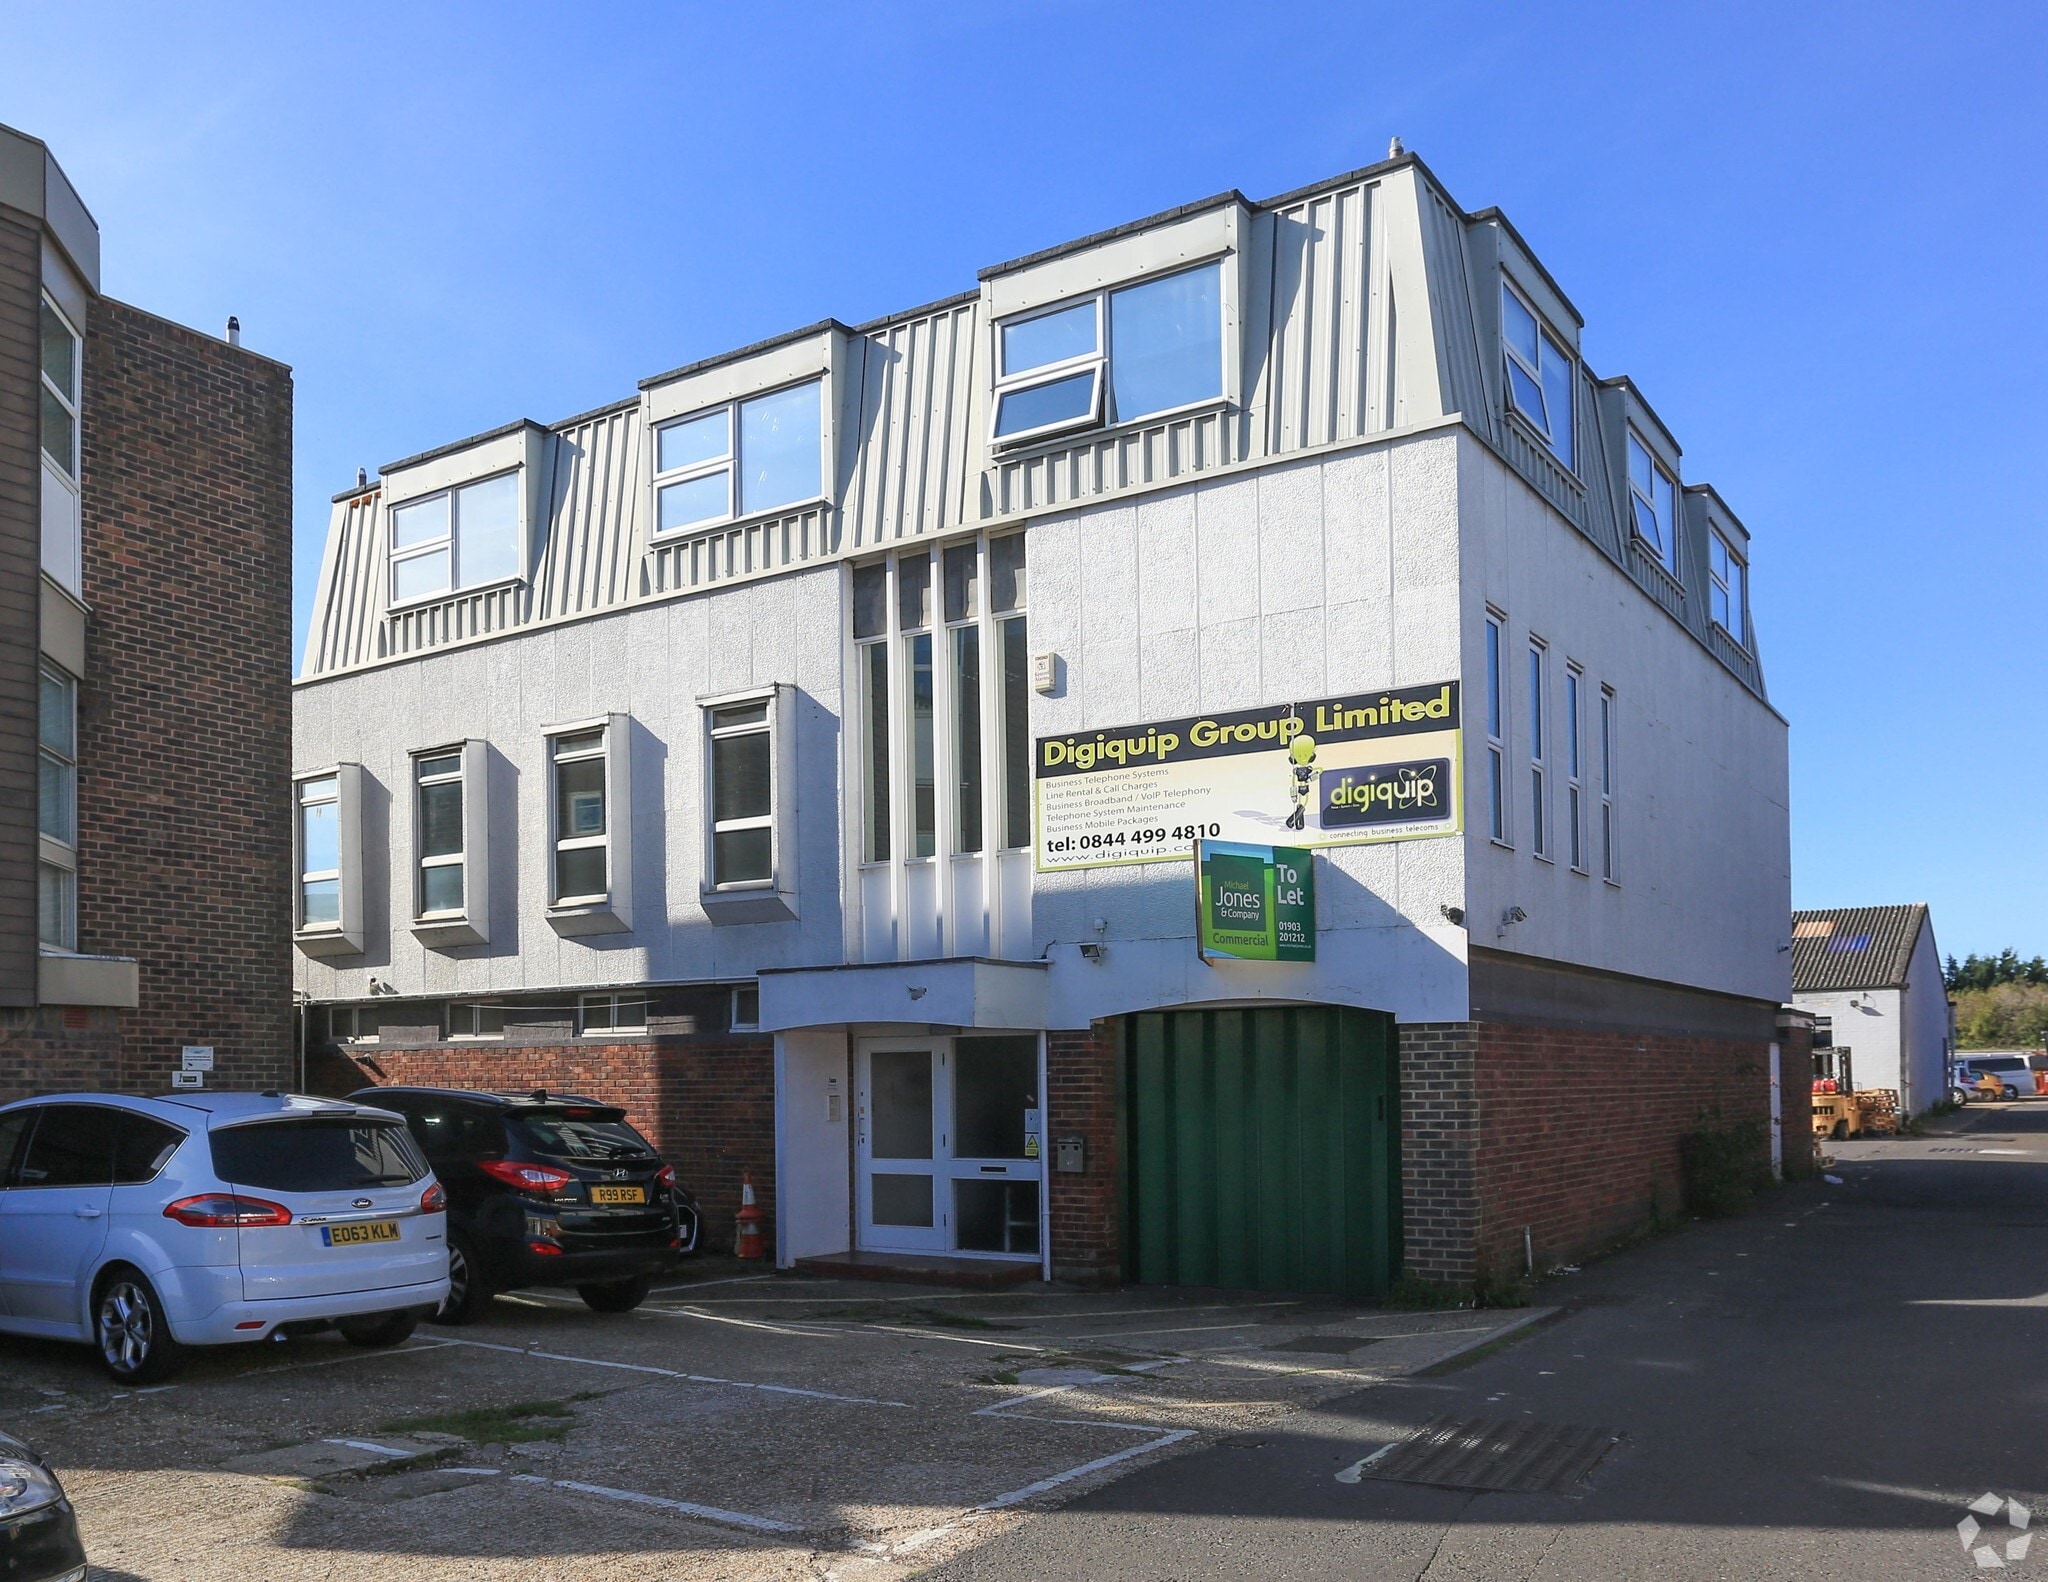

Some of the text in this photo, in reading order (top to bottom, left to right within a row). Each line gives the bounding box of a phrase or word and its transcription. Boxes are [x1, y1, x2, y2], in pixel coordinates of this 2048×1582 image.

[1044, 685, 1450, 770] Digiquip Group Limited
[1046, 769, 1169, 789] Business Telephone Systems
[1046, 781, 1158, 800] Line Rental & Call Charges
[1046, 801, 1082, 811] Business
[1085, 794, 1132, 807] Broadband
[1141, 791, 1161, 800] VoIP
[1163, 787, 1211, 798] Telephony
[1330, 771, 1434, 813] digiquip
[1046, 801, 1186, 822] Telephone System Maintenance
[1046, 815, 1159, 833] Business Mobile Packages
[1329, 824, 1439, 839] connecting business telecoms
[1047, 823, 1220, 852] tel: 0844 499 4810
[1046, 844, 1194, 863] www.digiquip.co
[1276, 864, 1297, 884] To
[1224, 881, 1249, 890] Michael
[1215, 886, 1260, 908] Jones
[1277, 885, 1304, 906] Let
[1228, 908, 1260, 920] Company
[1278, 921, 1301, 931] 01903
[1213, 932, 1269, 946] Commercial
[1279, 932, 1305, 942] 201212
[600, 1189, 638, 1201] R99 RSF
[332, 1223, 398, 1243] EO63 KLM
